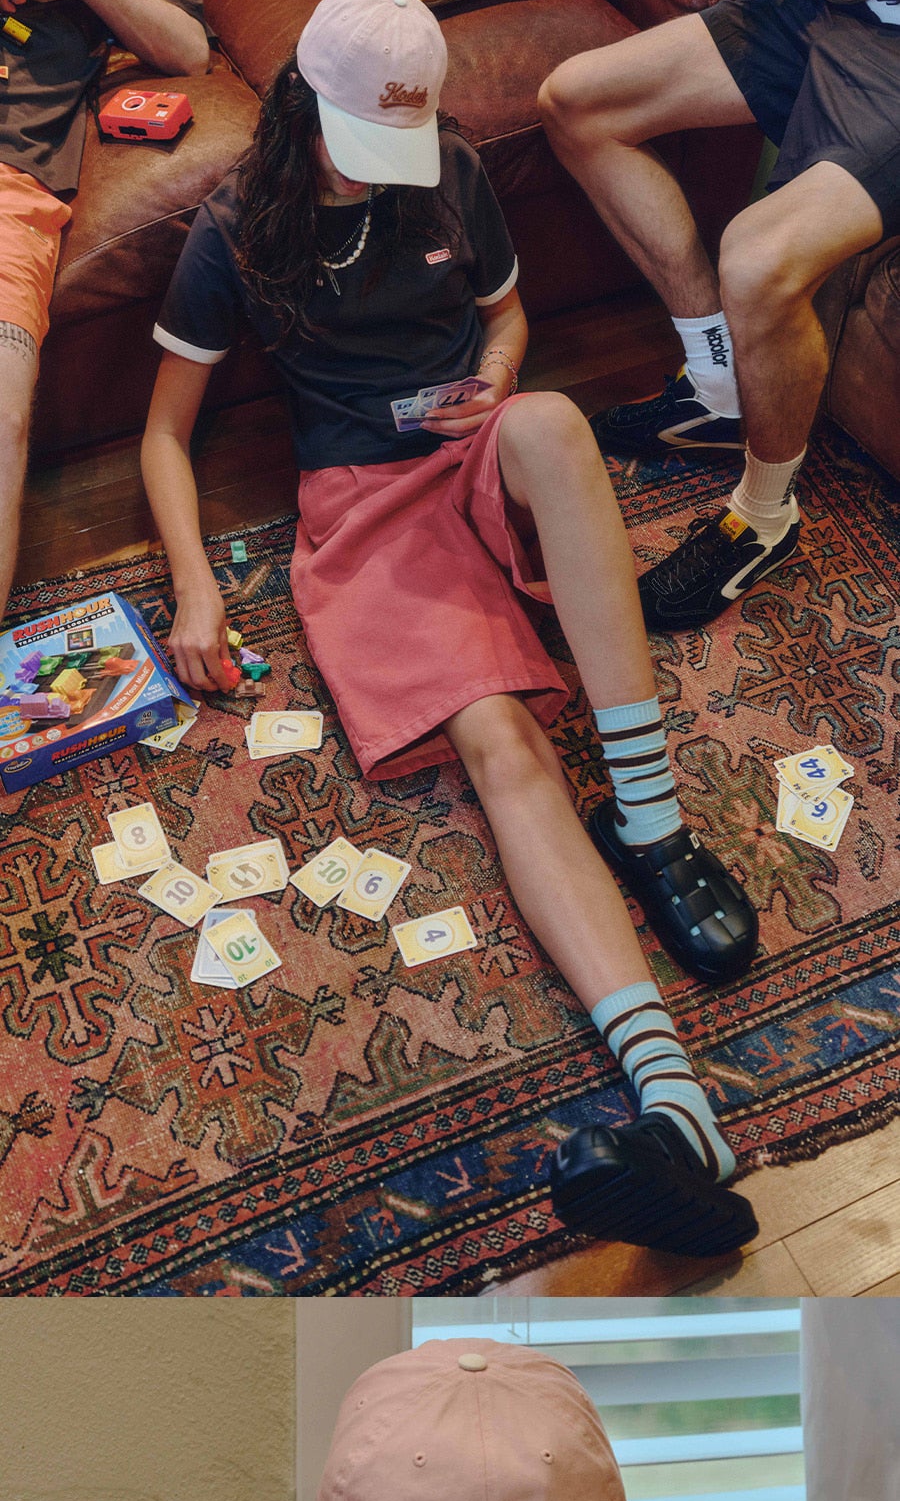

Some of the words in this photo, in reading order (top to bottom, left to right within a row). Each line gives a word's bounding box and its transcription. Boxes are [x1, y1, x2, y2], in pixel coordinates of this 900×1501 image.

[379, 81, 428, 107] Kodak
[12, 615, 60, 641] RUSH
[60, 598, 113, 625] HOUR
[18, 631, 48, 646] TRAFFIC
[49, 625, 66, 637] JAM
[67, 616, 89, 630] LOGIC
[91, 608, 113, 620] GAME
[110, 694, 128, 711] Ignite
[124, 682, 138, 697] Your
[277, 724, 298, 734] 7
[51, 740, 88, 760] RUSH
[87, 725, 127, 746] HOUR
[799, 758, 826, 778] 44
[131, 826, 146, 845] 8
[165, 881, 195, 906] 10
[424, 929, 447, 943] 4
